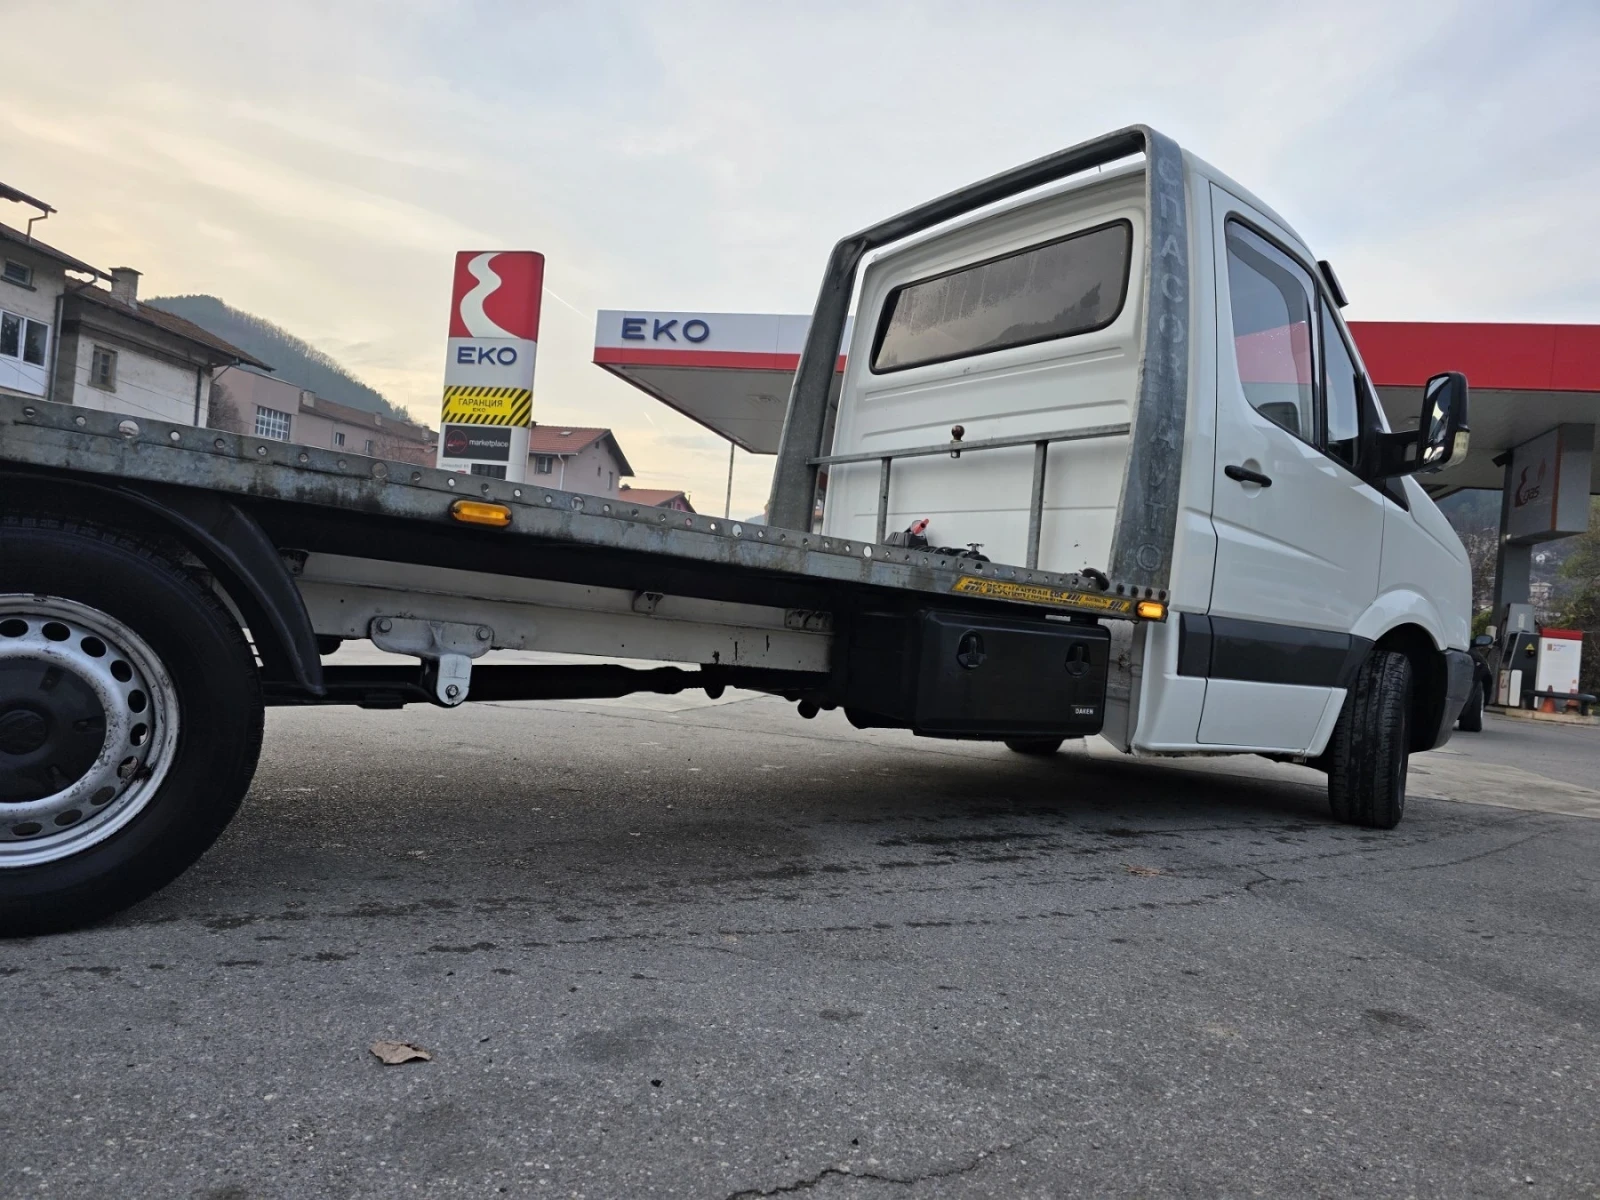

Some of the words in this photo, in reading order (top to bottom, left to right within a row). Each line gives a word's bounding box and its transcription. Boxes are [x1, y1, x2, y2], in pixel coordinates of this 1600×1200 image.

[621, 317, 710, 343] EKO
[456, 346, 518, 366] EKO
[458, 398, 504, 408] ГАРАНЦИЯ
[468, 438, 509, 448] marketplace
